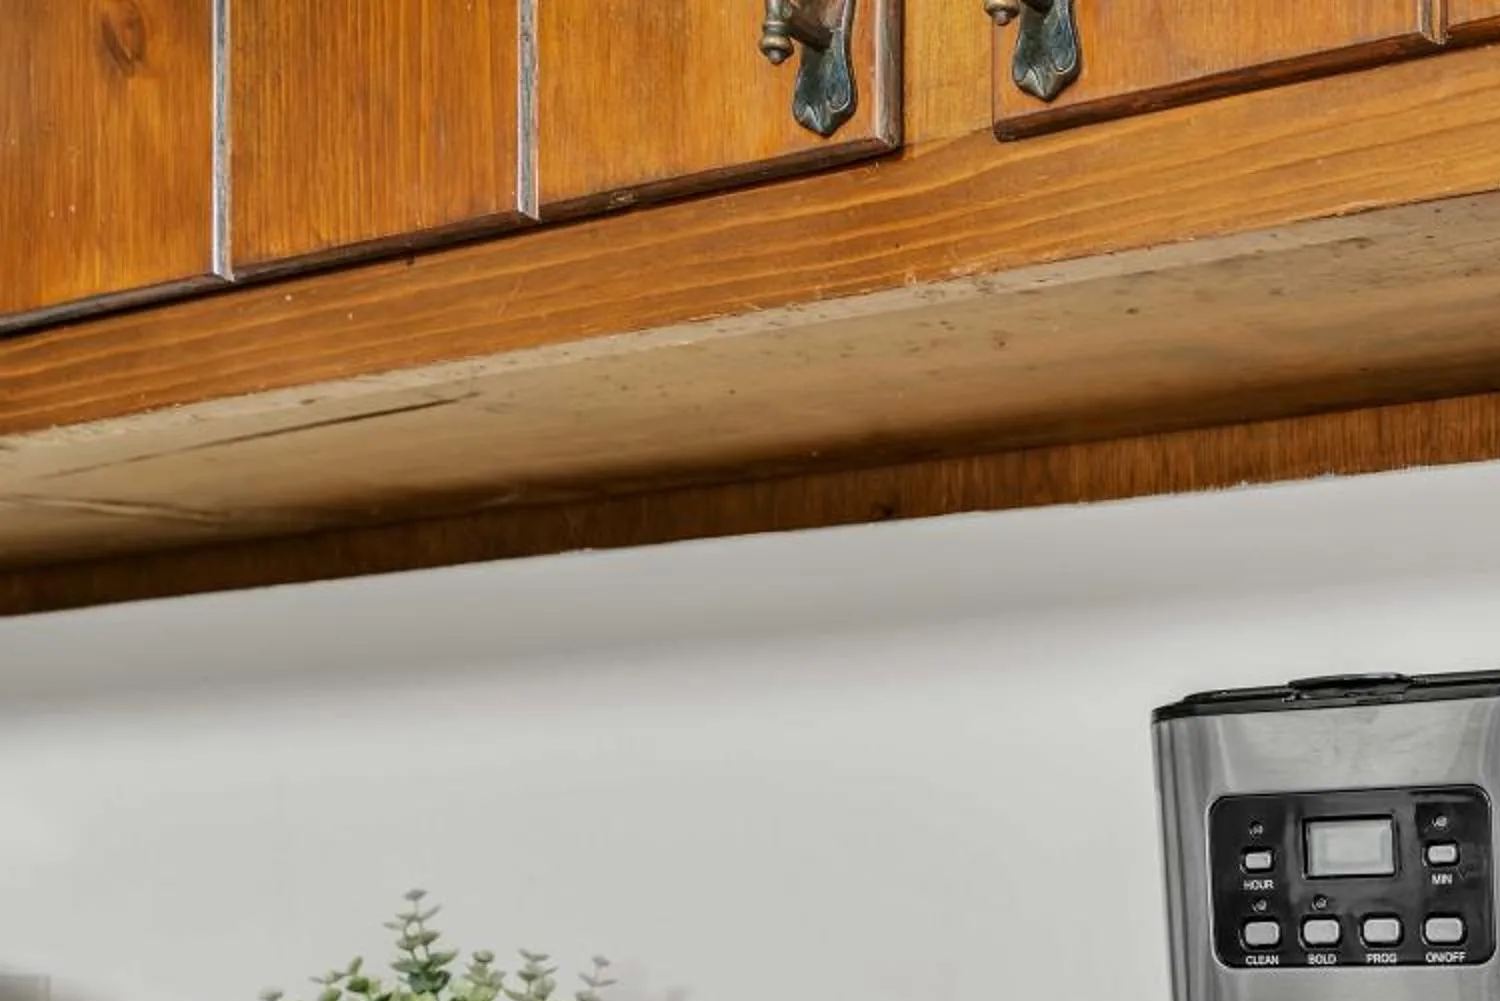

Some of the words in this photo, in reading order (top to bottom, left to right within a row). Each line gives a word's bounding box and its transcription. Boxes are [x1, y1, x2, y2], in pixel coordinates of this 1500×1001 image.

[1243, 879, 1274, 890] HOUR
[1431, 873, 1452, 885] MIN
[1245, 955, 1280, 966] CLEAN
[1308, 954, 1337, 965] BOLD
[1366, 953, 1397, 964] PROG
[1425, 952, 1466, 963] ON/OFF
